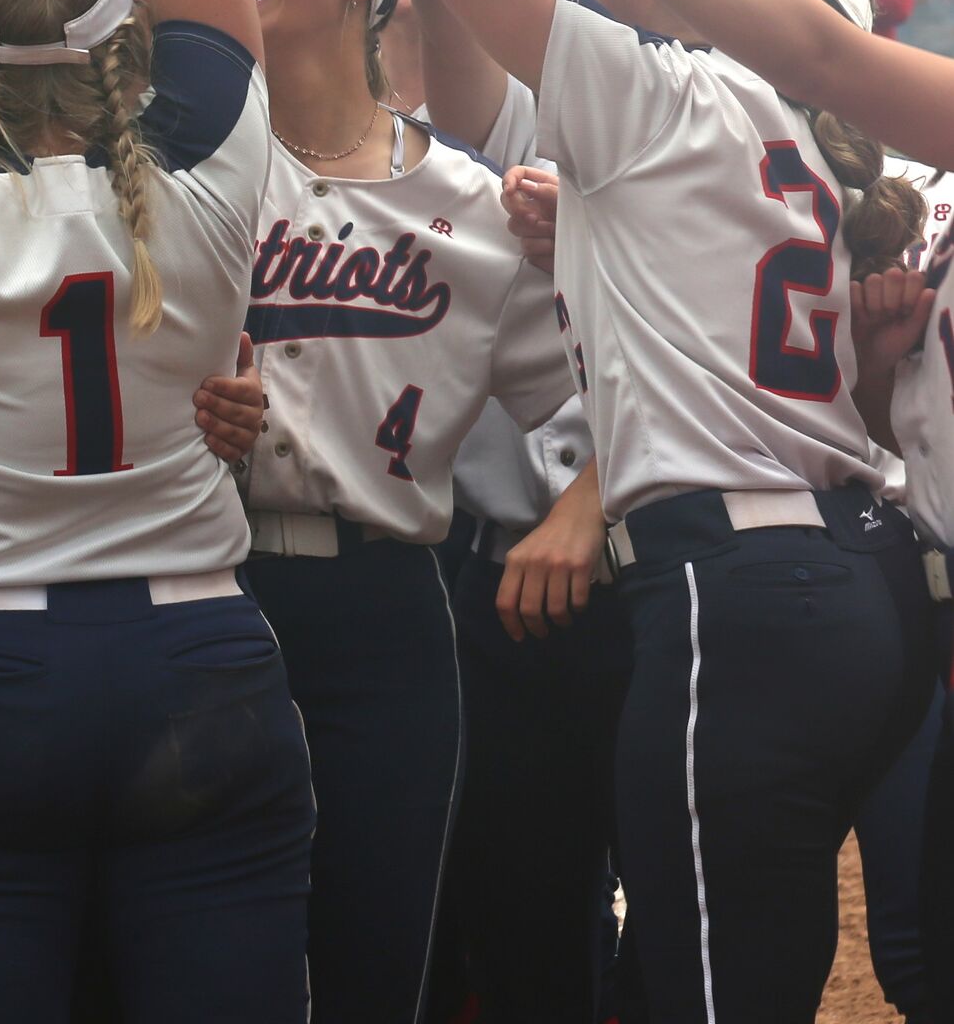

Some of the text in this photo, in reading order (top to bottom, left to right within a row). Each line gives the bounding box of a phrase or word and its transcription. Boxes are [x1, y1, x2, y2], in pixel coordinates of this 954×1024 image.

[250, 218, 451, 312] triots
[748, 139, 842, 404] 2
[39, 270, 134, 477] 1
[374, 383, 424, 483] 4
